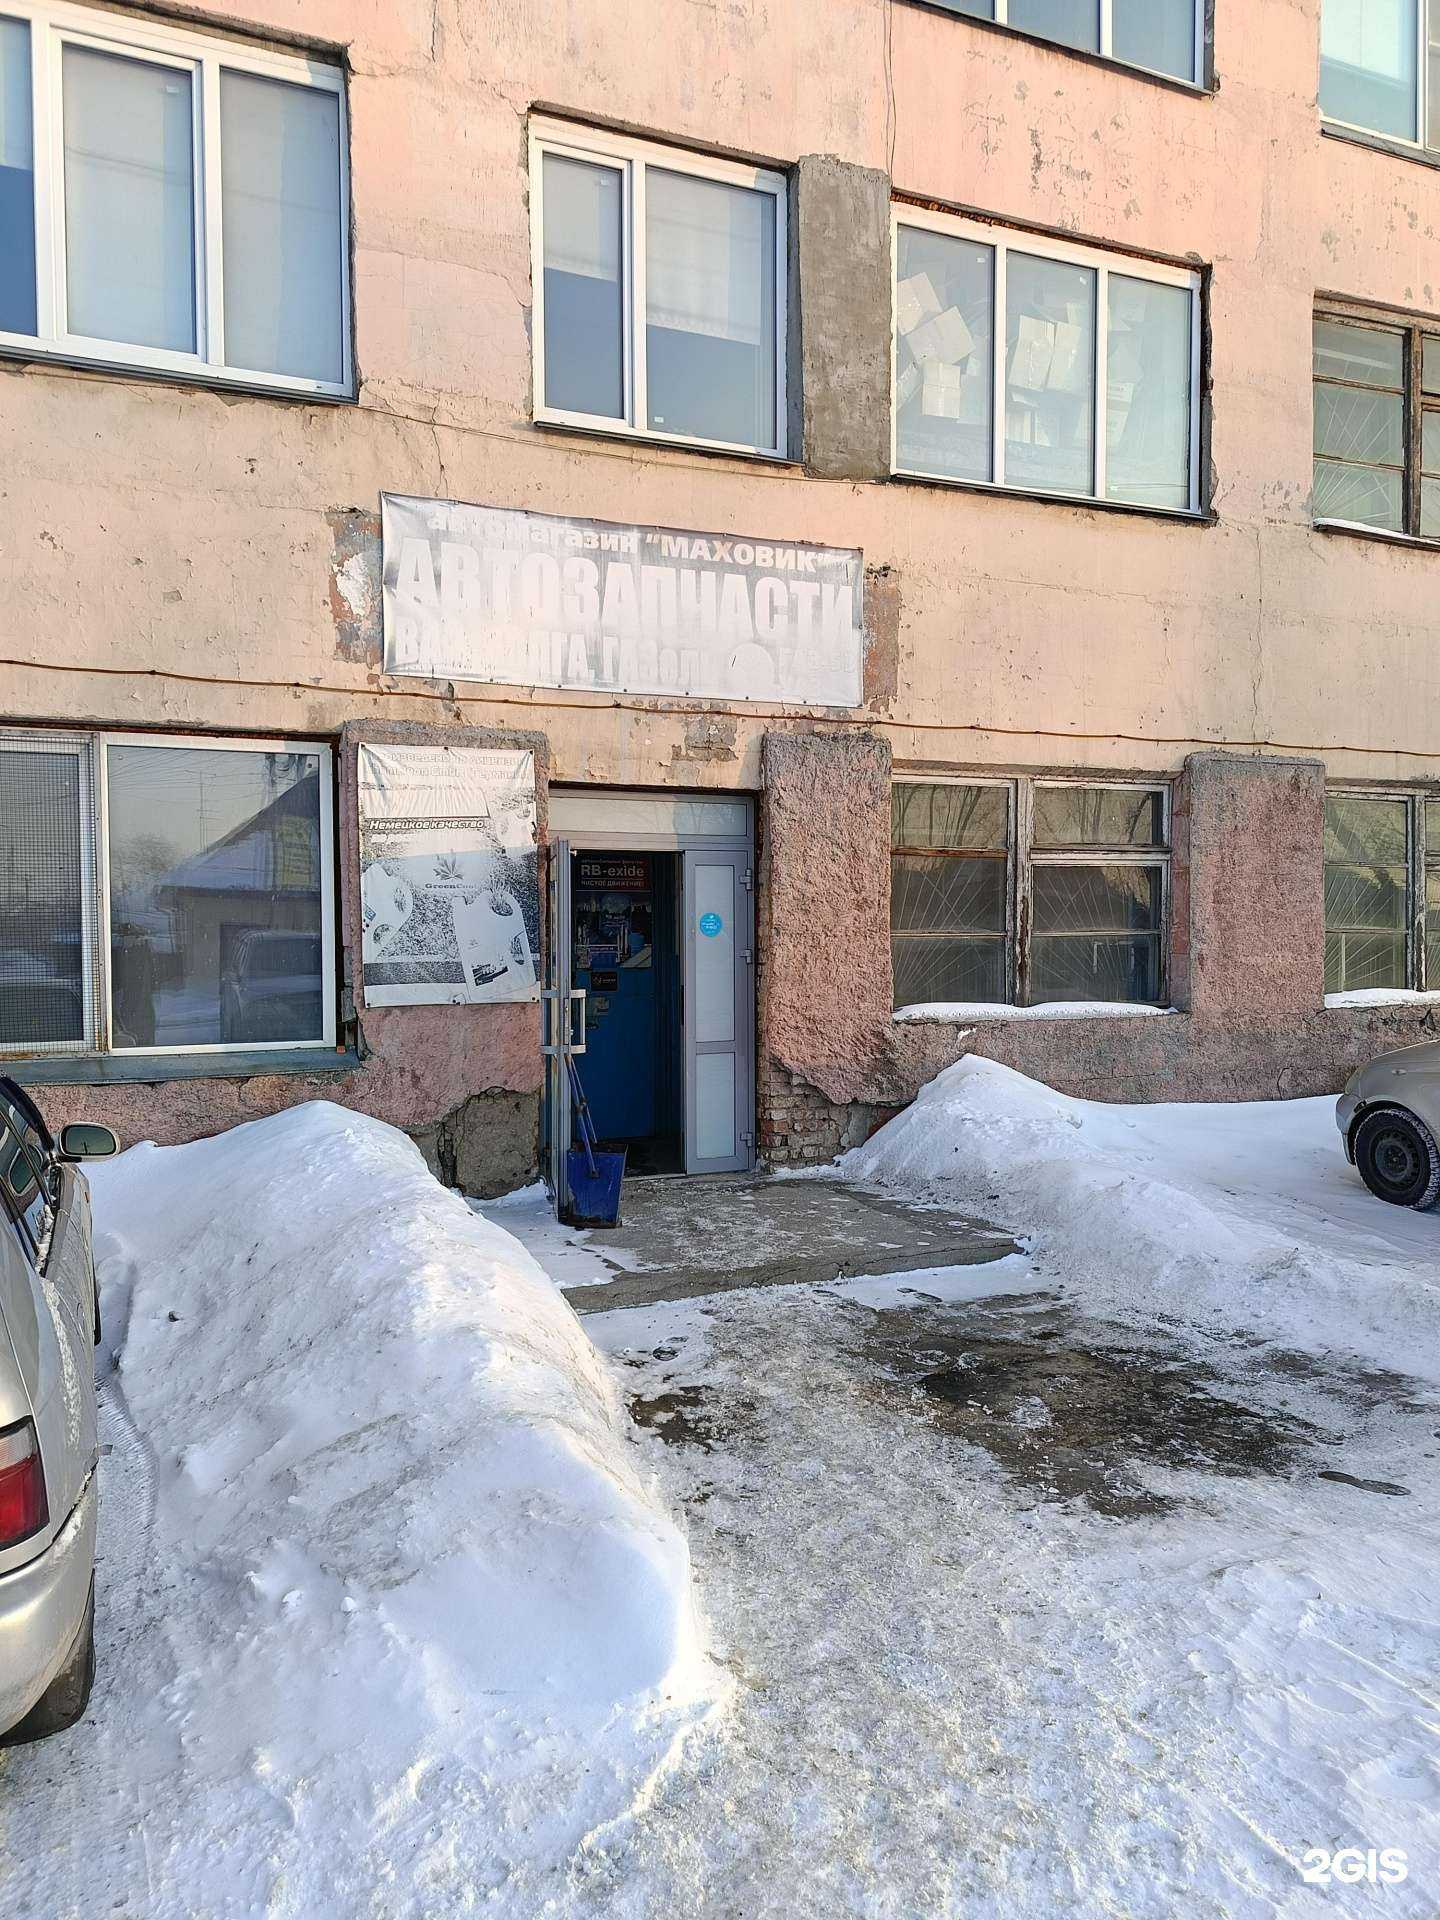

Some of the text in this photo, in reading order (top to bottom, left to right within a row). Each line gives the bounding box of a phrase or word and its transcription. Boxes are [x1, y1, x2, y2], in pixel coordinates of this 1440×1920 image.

[396, 537, 853, 643] АВТОЗАПЧАСТИ
[369, 820, 484, 830] Немецкое качество
[580, 864, 645, 876] RB-exide
